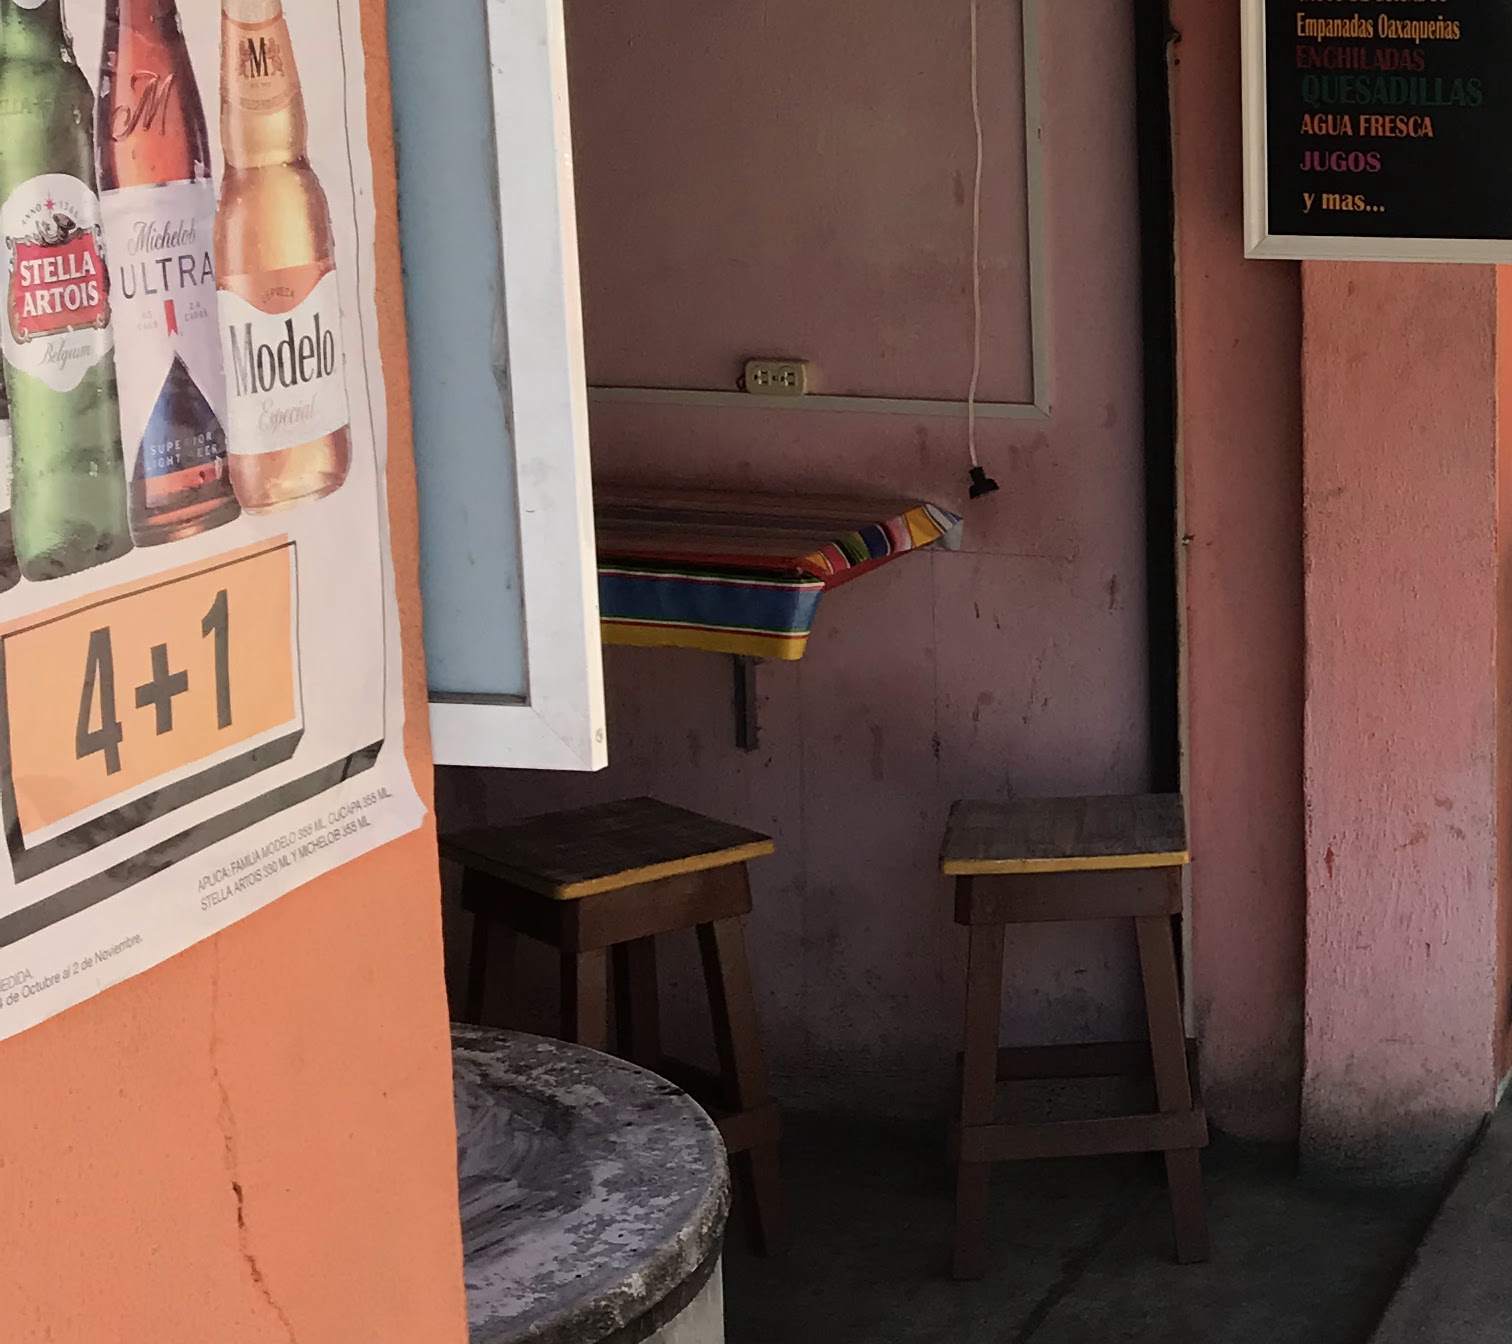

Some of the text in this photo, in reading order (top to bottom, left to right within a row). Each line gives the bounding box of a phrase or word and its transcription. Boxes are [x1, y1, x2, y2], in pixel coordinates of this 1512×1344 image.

[1296, 12, 1461, 44] Empanadas Oaxaqueñas
[248, 37, 268, 78] M
[1295, 45, 1426, 72] ENCHILADAS
[1301, 75, 1483, 108] QUESADILLAS
[1300, 113, 1434, 138] AGUA FRESCA
[1300, 151, 1382, 172] JUGOS
[1303, 192, 1386, 213] y mas...
[127, 219, 197, 256] Michelob
[20, 251, 96, 287] STELLA
[120, 251, 215, 299] ULTRA
[22, 280, 99, 318] ARTOIS
[229, 312, 335, 396] Modelo
[150, 433, 213, 456] SUPEIOR
[75, 588, 233, 777] 4+1
[260, 831, 297, 861] MODELO
[201, 883, 234, 911] STELLA
[234, 868, 263, 894] ARTOIS
[298, 828, 342, 859] MICHELOB
[6, 992, 20, 1006] de
[21, 972, 61, 999] Octubre
[62, 965, 71, 979] al
[72, 961, 80, 975] 2
[80, 956, 94, 971] de
